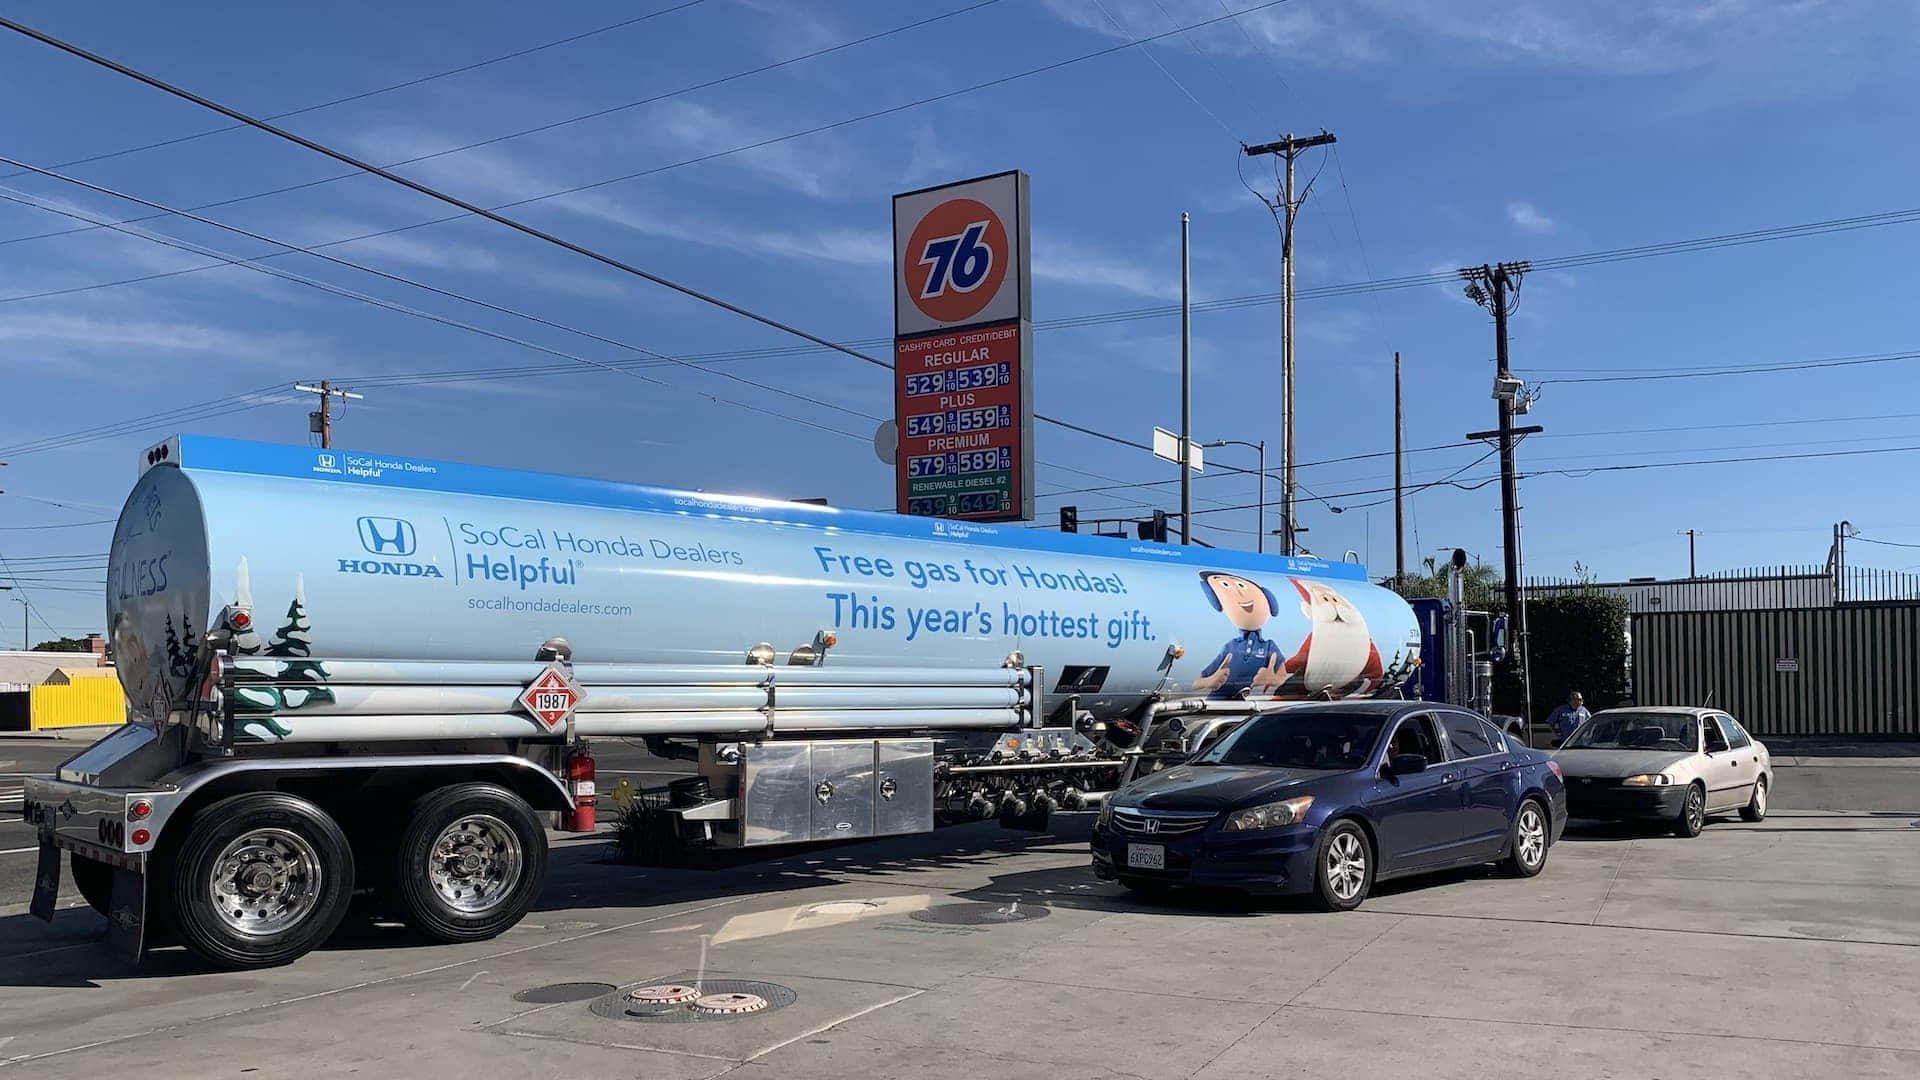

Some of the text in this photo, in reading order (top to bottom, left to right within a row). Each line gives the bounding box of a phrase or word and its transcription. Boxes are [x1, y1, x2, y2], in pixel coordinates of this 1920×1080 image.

[918, 220, 993, 299] 76
[898, 328, 1017, 353] CASH/76 CARD CREDIT/DEBIT
[924, 347, 990, 367] REGULAR
[947, 371, 954, 379] 9
[1000, 364, 1007, 372] 9
[907, 374, 943, 395] 529
[959, 367, 995, 388] 539
[999, 375, 1009, 385] 10
[946, 382, 956, 391] 10
[940, 393, 975, 409] PLUS
[948, 412, 954, 421] 9
[1001, 406, 1007, 415] 9
[908, 415, 943, 435] 549
[961, 409, 995, 430] 559
[1000, 417, 1010, 427] 10
[947, 423, 957, 433] 10
[928, 433, 990, 451] PREMIUM
[949, 454, 955, 462] 9
[1002, 448, 1008, 457] 9
[347, 456, 437, 474] SoCal Honda Dealers
[909, 456, 945, 476] 579
[948, 464, 957, 474] 10
[960, 452, 996, 472] 589
[1000, 459, 1010, 469] 10
[912, 481, 964, 492] RENEWABLE
[965, 477, 995, 488] DIESEL
[949, 495, 955, 503] 9
[1002, 490, 1009, 499] 9
[948, 505, 957, 515] 10
[960, 494, 997, 513] 649
[1000, 501, 1011, 512] 10
[460, 523, 744, 566] SoCal Honda Dealers
[337, 559, 444, 578] HONDA
[814, 546, 1128, 594] Free gas for Hondas!
[468, 596, 632, 616] socalhondadealers.com
[826, 592, 1157, 649] This year's hottest gift.
[538, 694, 567, 709] 1987
[549, 711, 556, 721] 3
